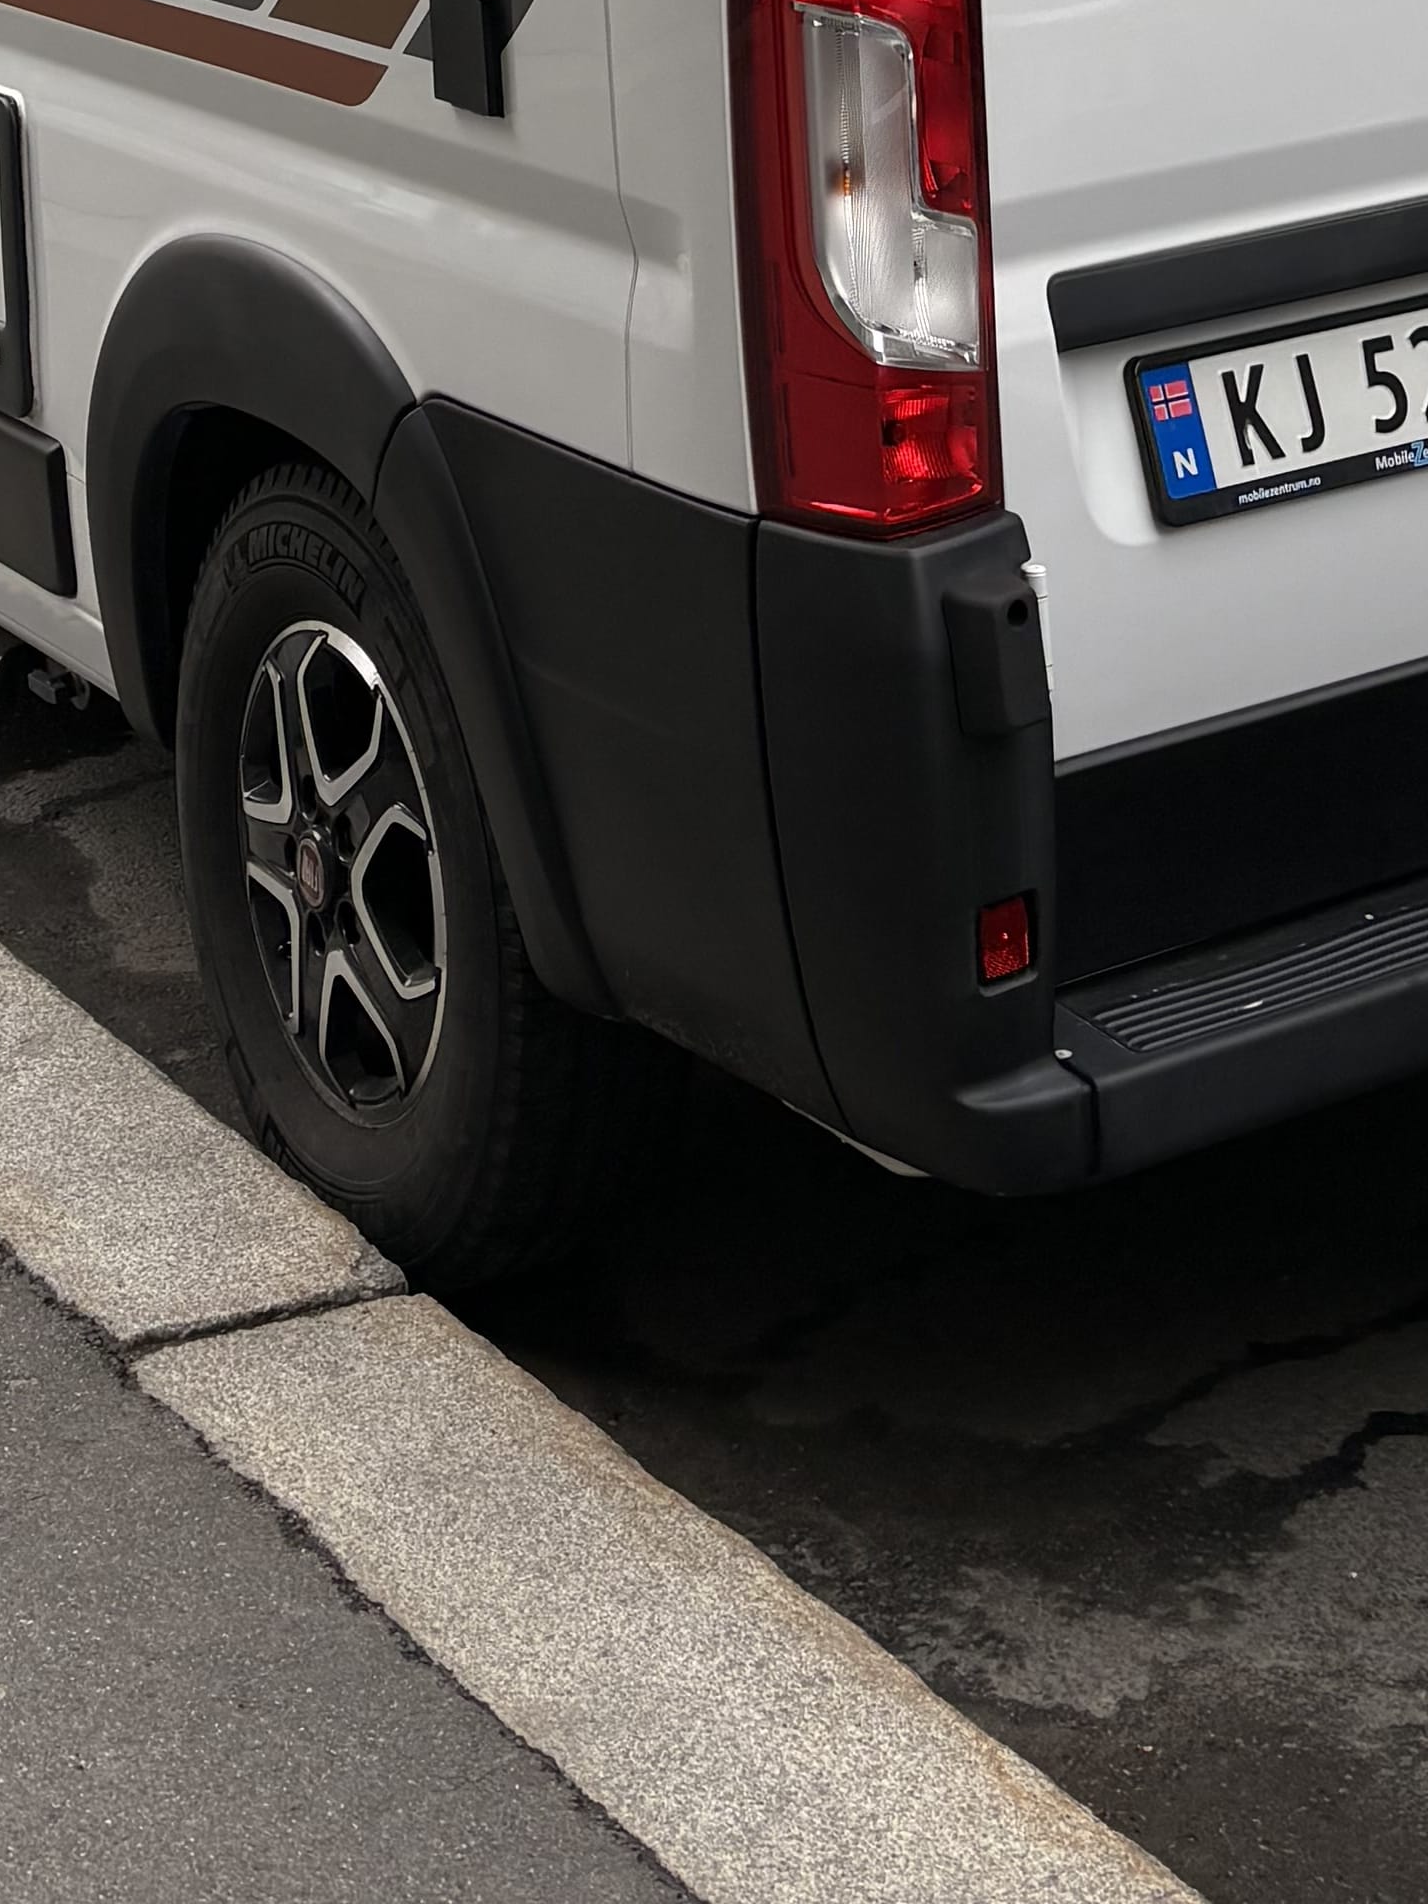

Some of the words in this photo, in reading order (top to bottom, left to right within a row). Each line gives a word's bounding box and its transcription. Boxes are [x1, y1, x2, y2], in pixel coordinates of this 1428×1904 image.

[1220, 353, 1326, 467] KJ
[1171, 447, 1199, 481] N
[1238, 477, 1321, 504] mobilezentrum.no
[248, 523, 366, 609] MICHELIN
